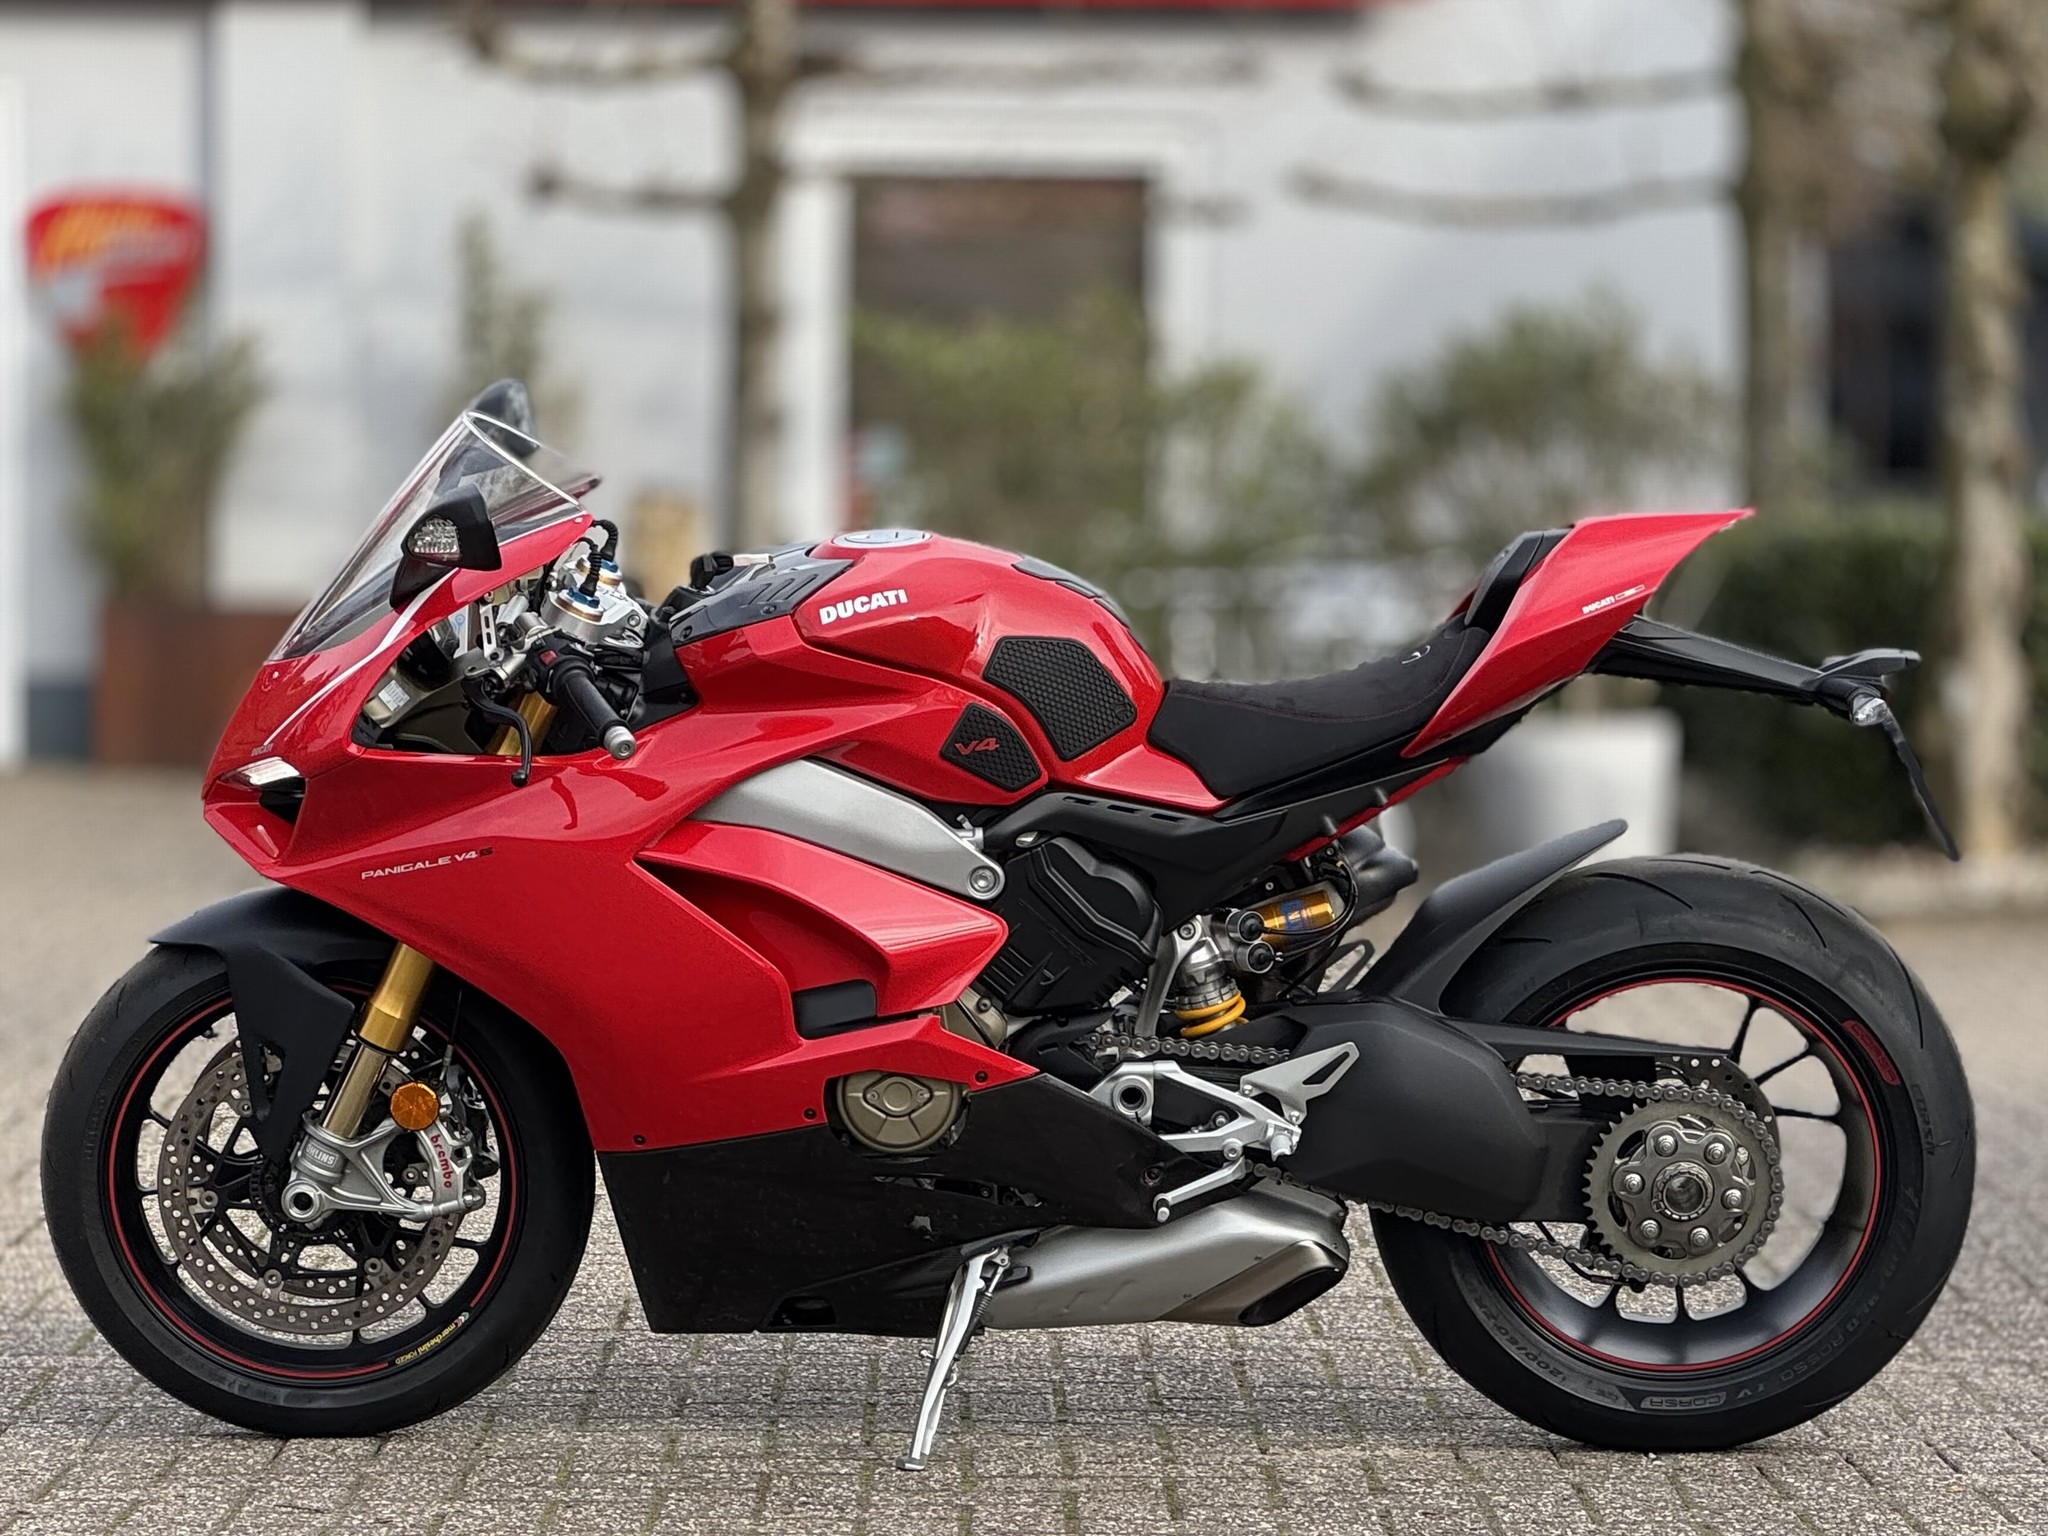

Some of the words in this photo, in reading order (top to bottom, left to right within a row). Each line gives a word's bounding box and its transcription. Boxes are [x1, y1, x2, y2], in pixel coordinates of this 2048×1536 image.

[819, 588, 908, 626] DUCATI
[1582, 595, 1616, 615] DUCATI
[955, 737, 999, 756] V4
[361, 856, 451, 880] PANIGALE
[431, 1134, 454, 1188] brembo
[1650, 1394, 1721, 1408] CORSA
